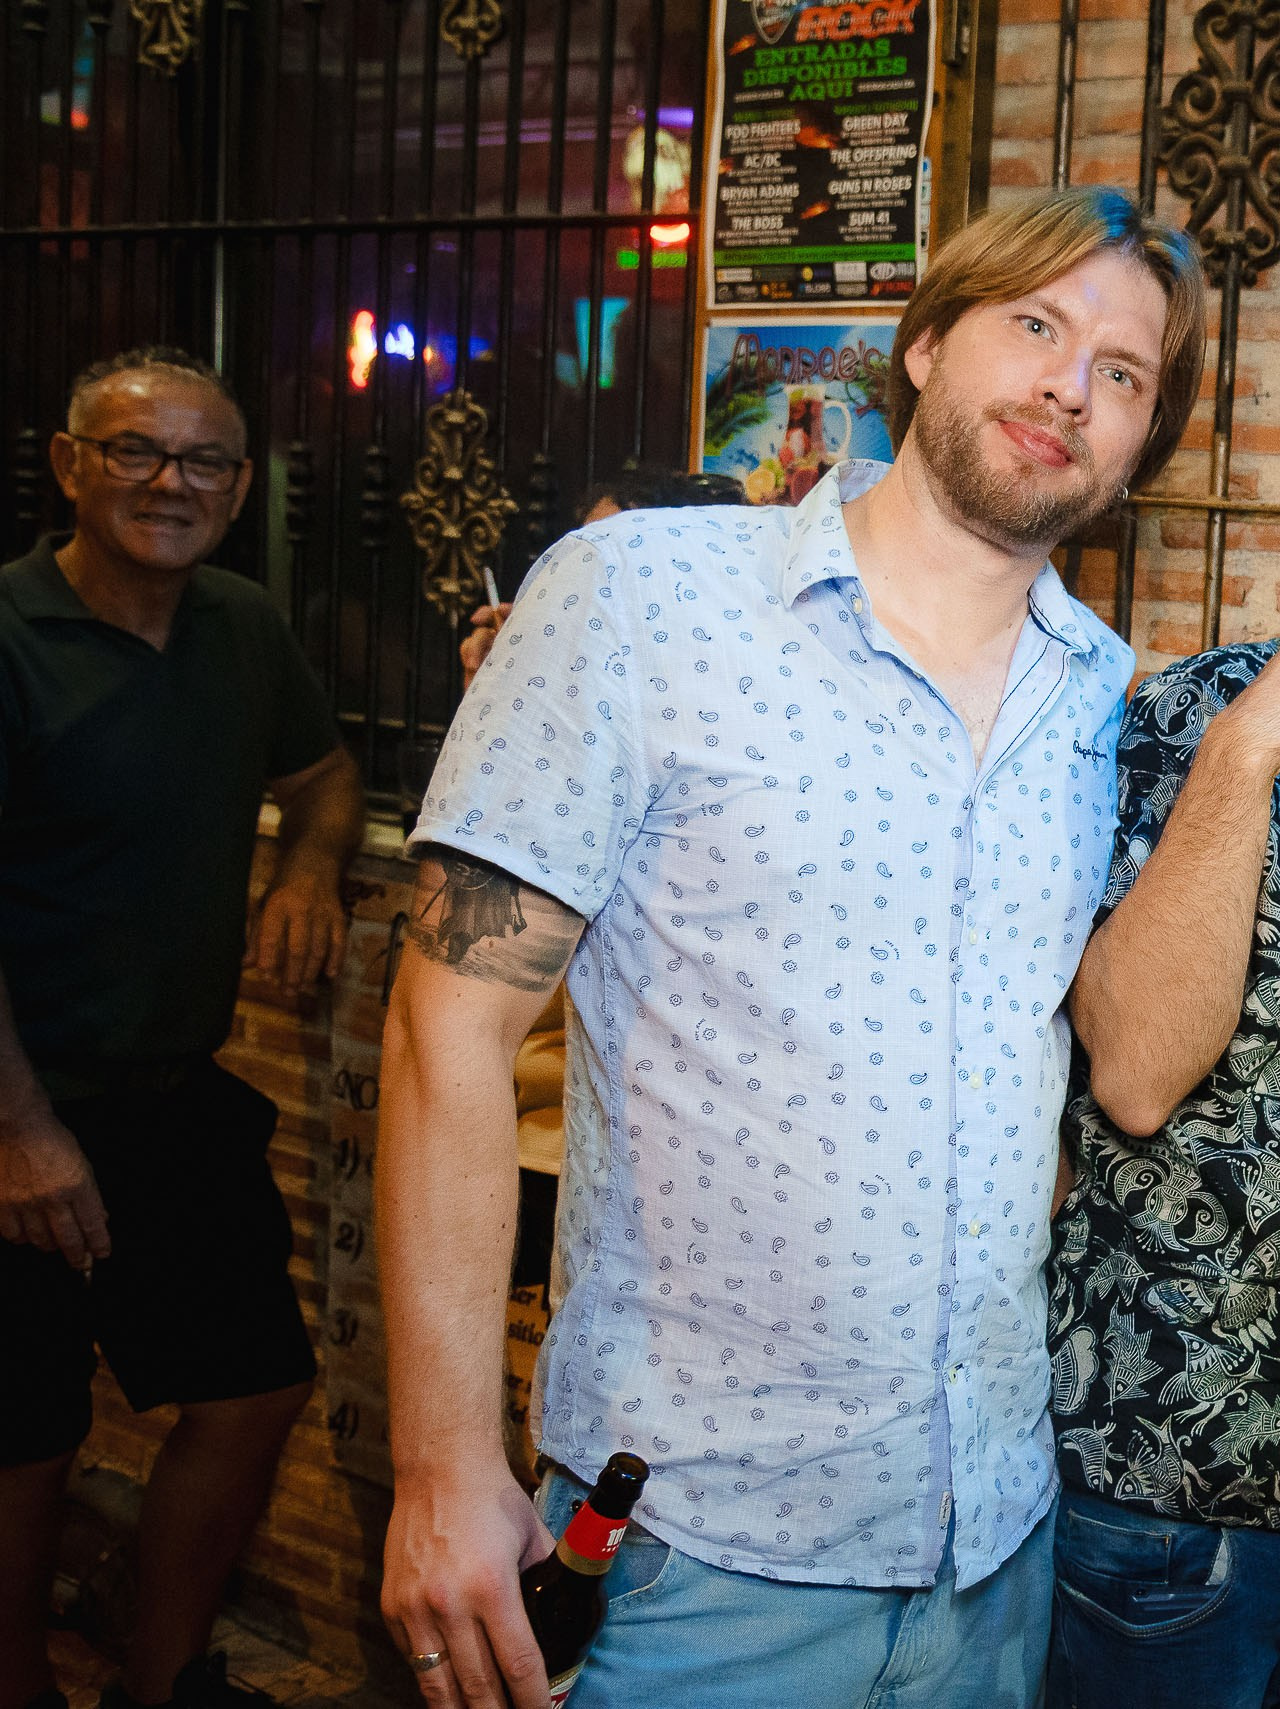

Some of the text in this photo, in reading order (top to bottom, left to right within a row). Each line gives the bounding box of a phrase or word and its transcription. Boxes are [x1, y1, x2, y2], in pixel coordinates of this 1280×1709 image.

[754, 38, 891, 68] ENTRADAS
[743, 56, 908, 88] DISPONIBLES
[725, 119, 801, 140] FOO FIGHTERS
[842, 113, 909, 131] GREEN DAY
[743, 152, 782, 169] AC/DC
[830, 144, 917, 164] THE OFFSPRING
[720, 183, 800, 202] BRYAN ADAMS
[828, 181, 861, 195] GUNS
[873, 176, 912, 192] ROSES
[731, 214, 784, 231] THE BOSS
[849, 210, 890, 226] SUM 41
